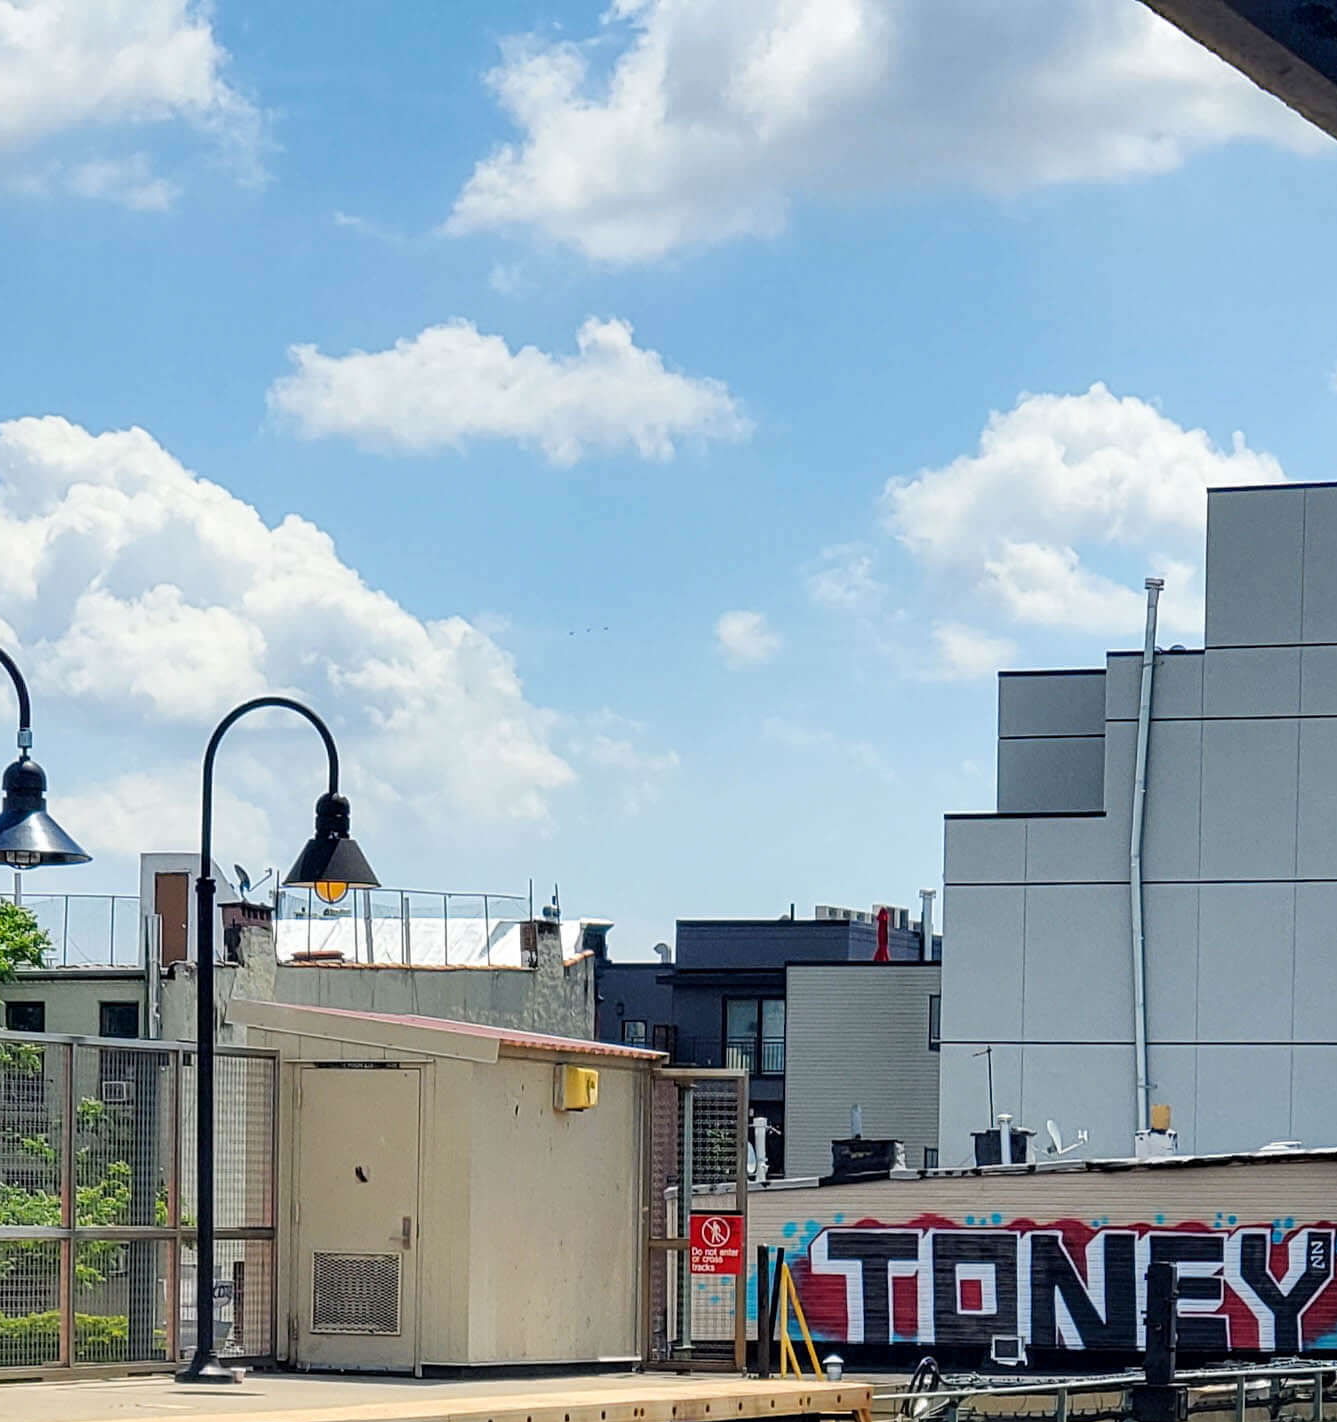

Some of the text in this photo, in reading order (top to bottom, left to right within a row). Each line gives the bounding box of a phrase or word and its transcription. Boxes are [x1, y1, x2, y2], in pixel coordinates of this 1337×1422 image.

[691, 1247, 739, 1257] Do not enter
[810, 1228, 1337, 1353] TONEY
